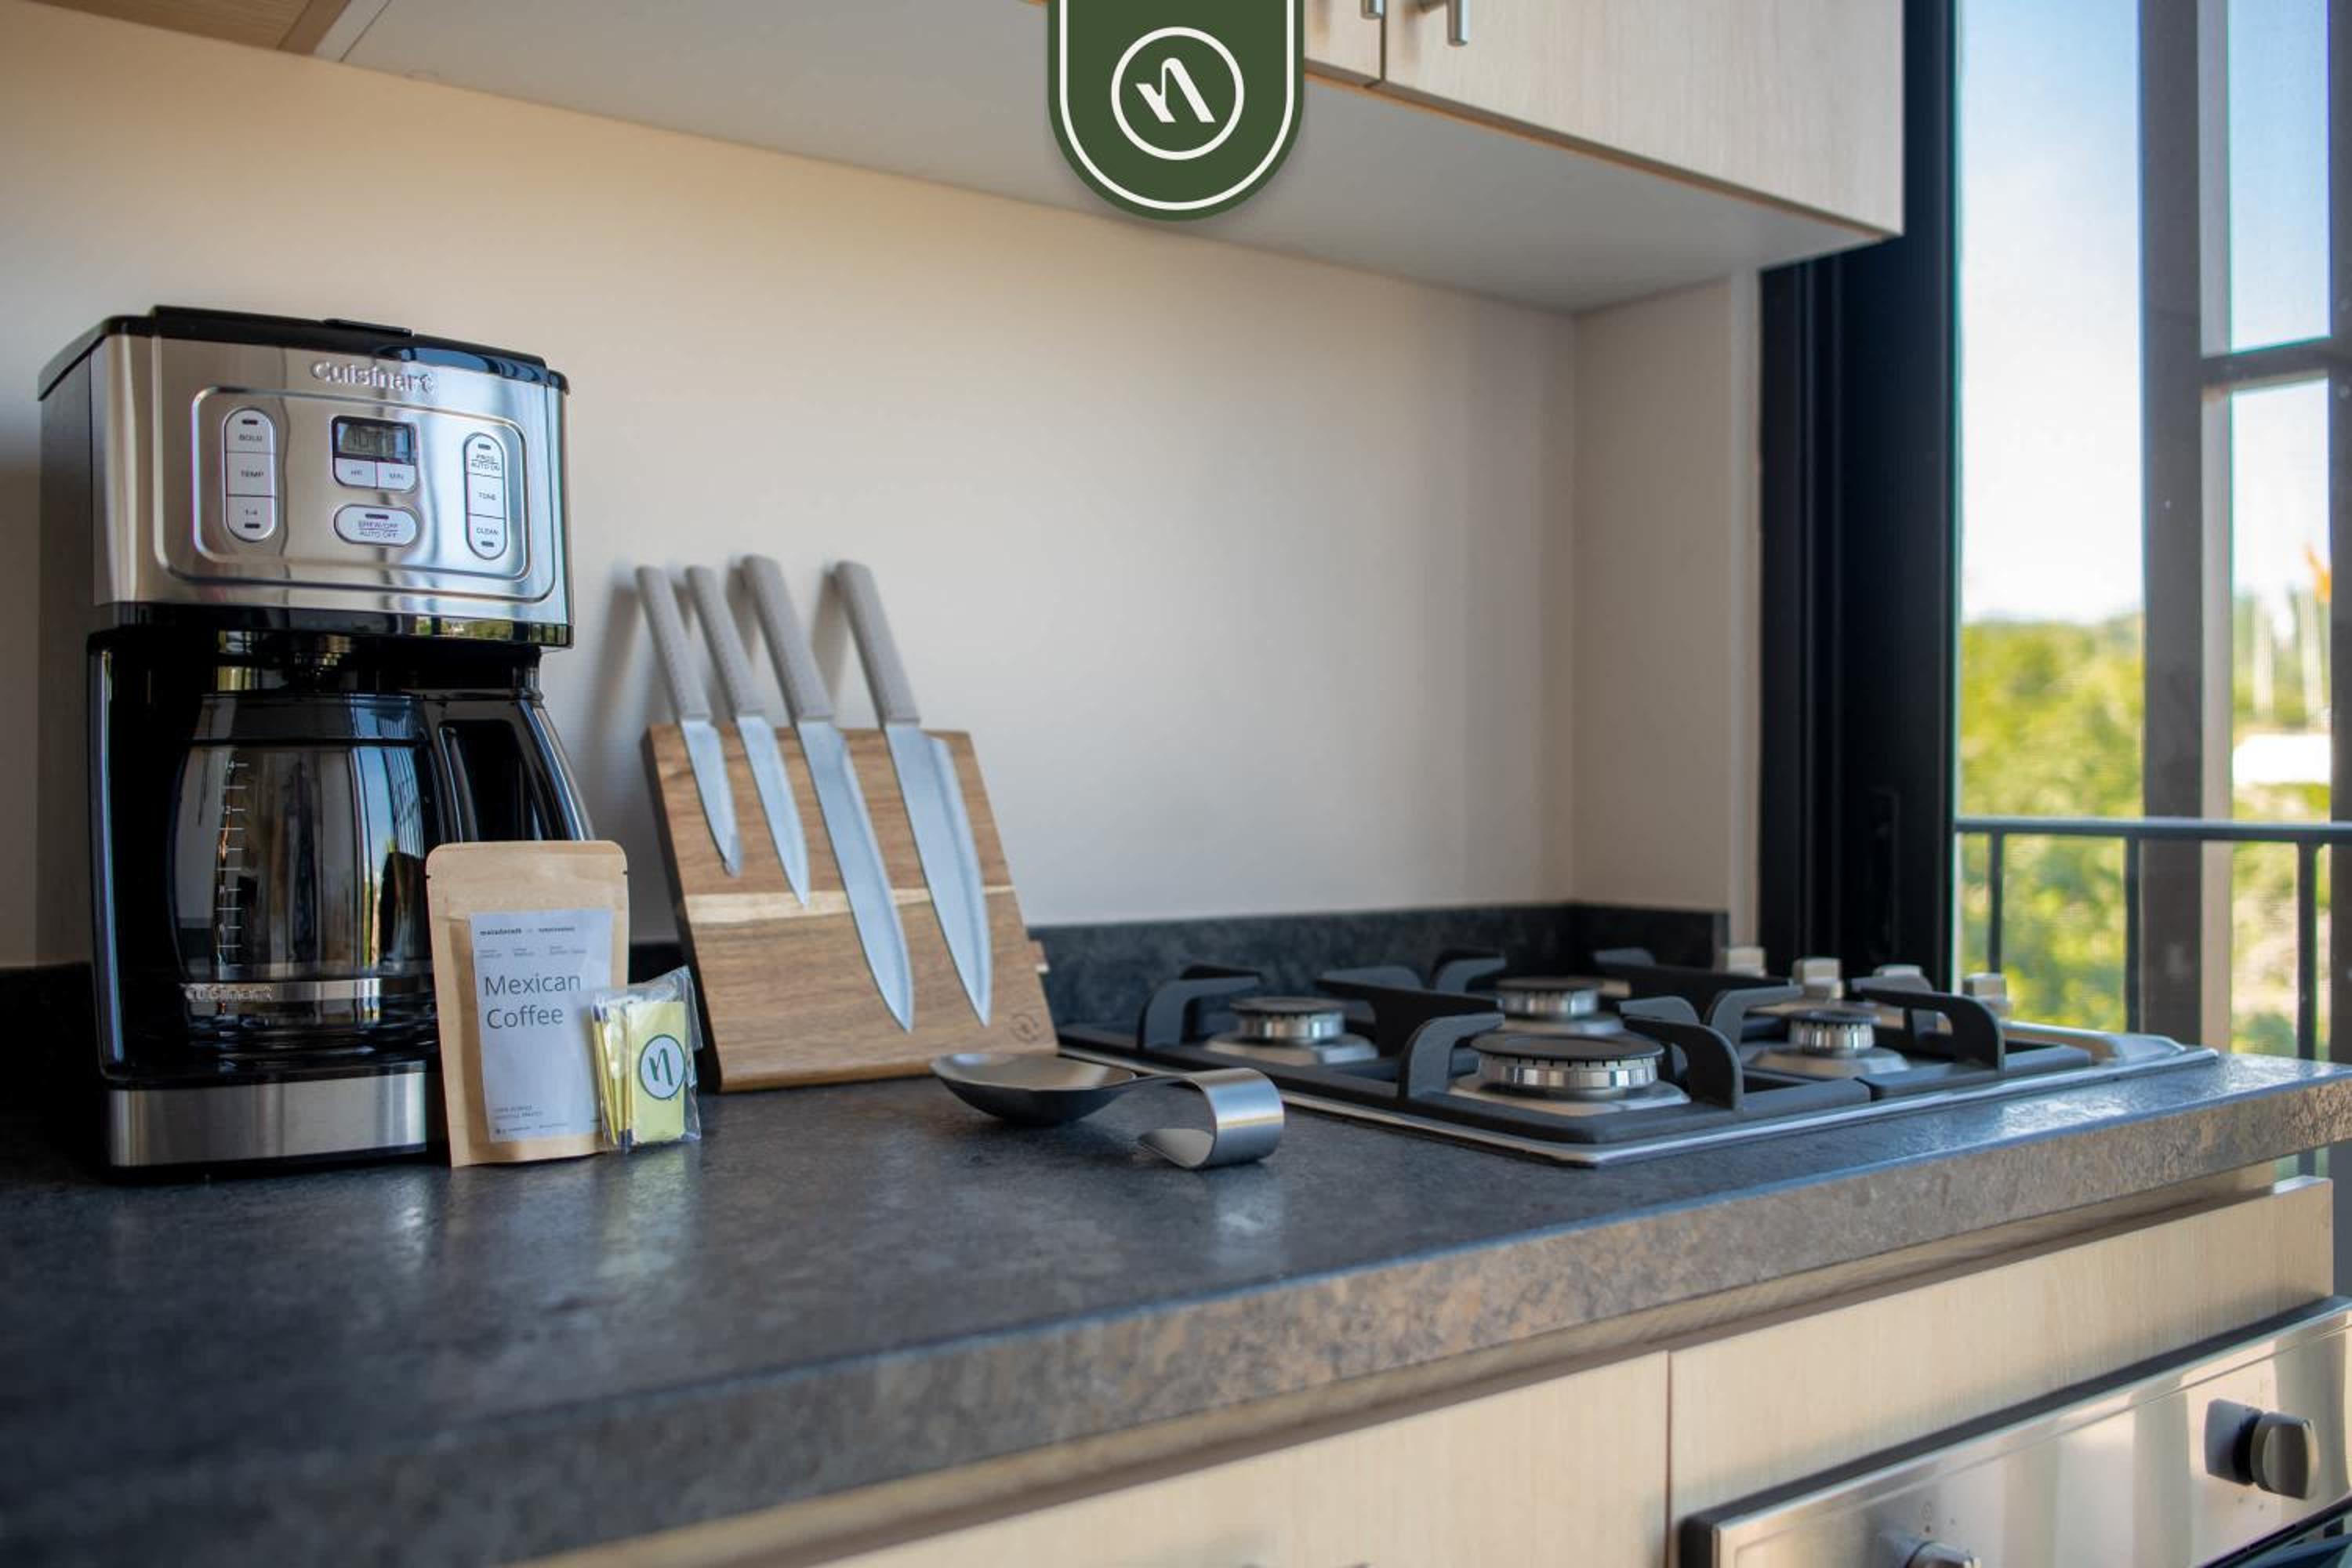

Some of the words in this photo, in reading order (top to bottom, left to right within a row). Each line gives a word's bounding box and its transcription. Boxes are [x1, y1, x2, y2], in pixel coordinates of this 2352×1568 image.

[310, 361, 434, 393] Cuisinart
[478, 492, 496, 501] TONE
[485, 973, 581, 996] Mexican
[487, 1004, 564, 1029] Coffee
